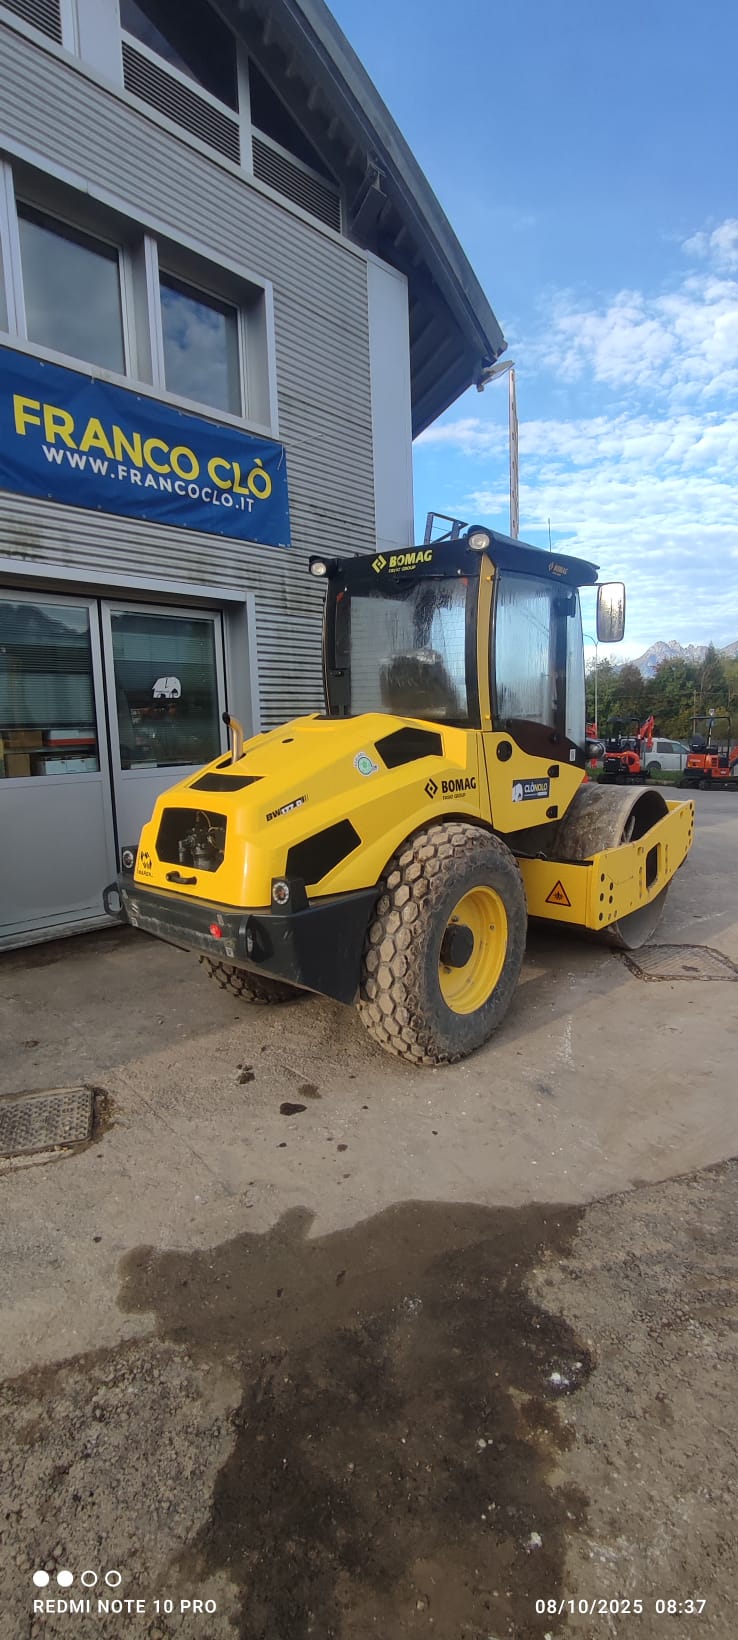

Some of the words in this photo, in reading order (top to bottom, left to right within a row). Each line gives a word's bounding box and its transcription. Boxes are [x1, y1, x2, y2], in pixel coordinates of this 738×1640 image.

[13, 394, 200, 481] FRANCO
[207, 457, 272, 499] CLÒ
[41, 444, 255, 513] WWW.FRANCOCLO.IT
[389, 549, 433, 568] BOMAG
[441, 777, 477, 794] BOMAG
